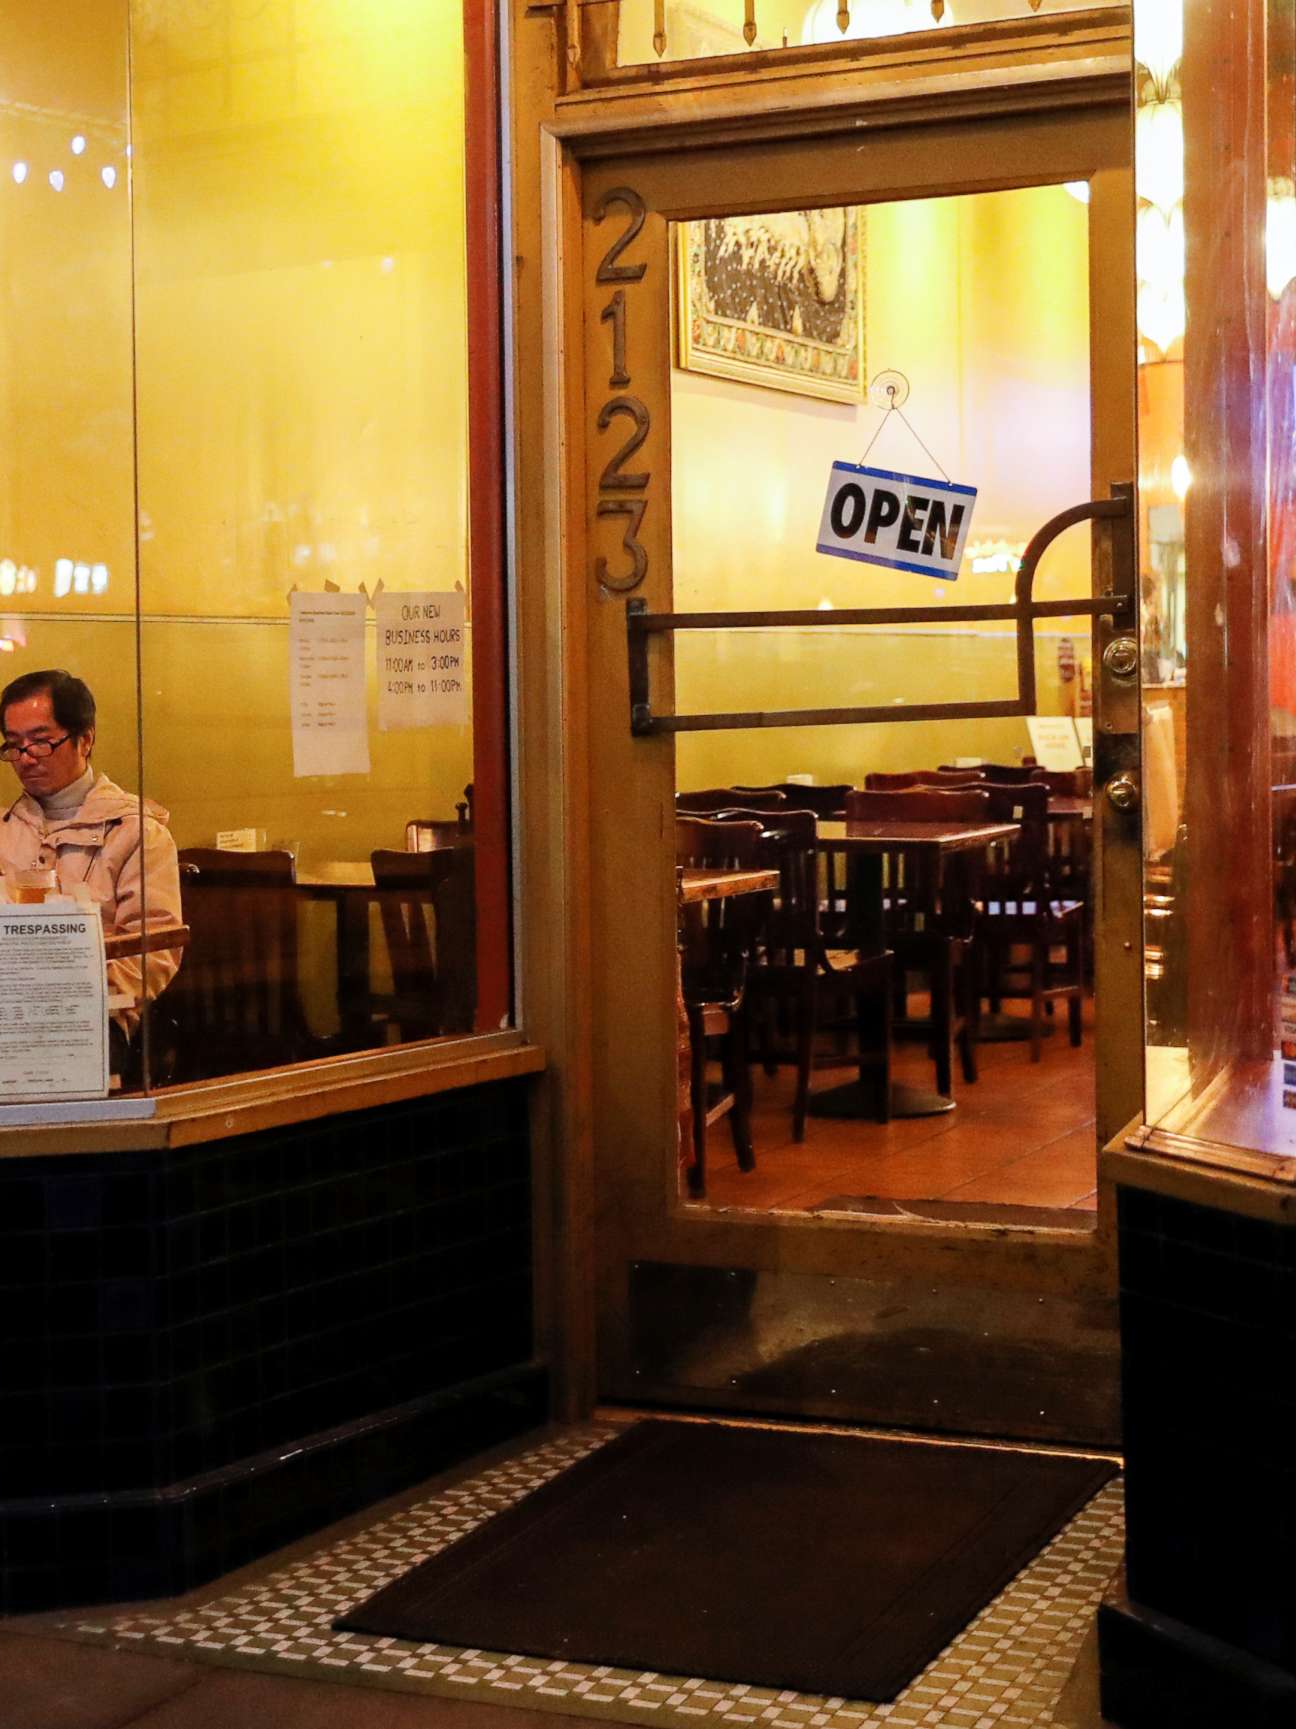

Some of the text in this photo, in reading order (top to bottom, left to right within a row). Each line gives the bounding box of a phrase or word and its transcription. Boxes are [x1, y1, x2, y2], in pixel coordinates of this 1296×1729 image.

[594, 186, 651, 594] 2123
[830, 482, 965, 561] OPEN
[401, 604, 441, 621] OUR NEW
[385, 628, 461, 646] BUSINESS HOURS
[417, 660, 425, 671] to
[431, 655, 460, 671] 3:00PM
[417, 683, 426, 693] to
[4, 923, 87, 935] TRESPASSING
